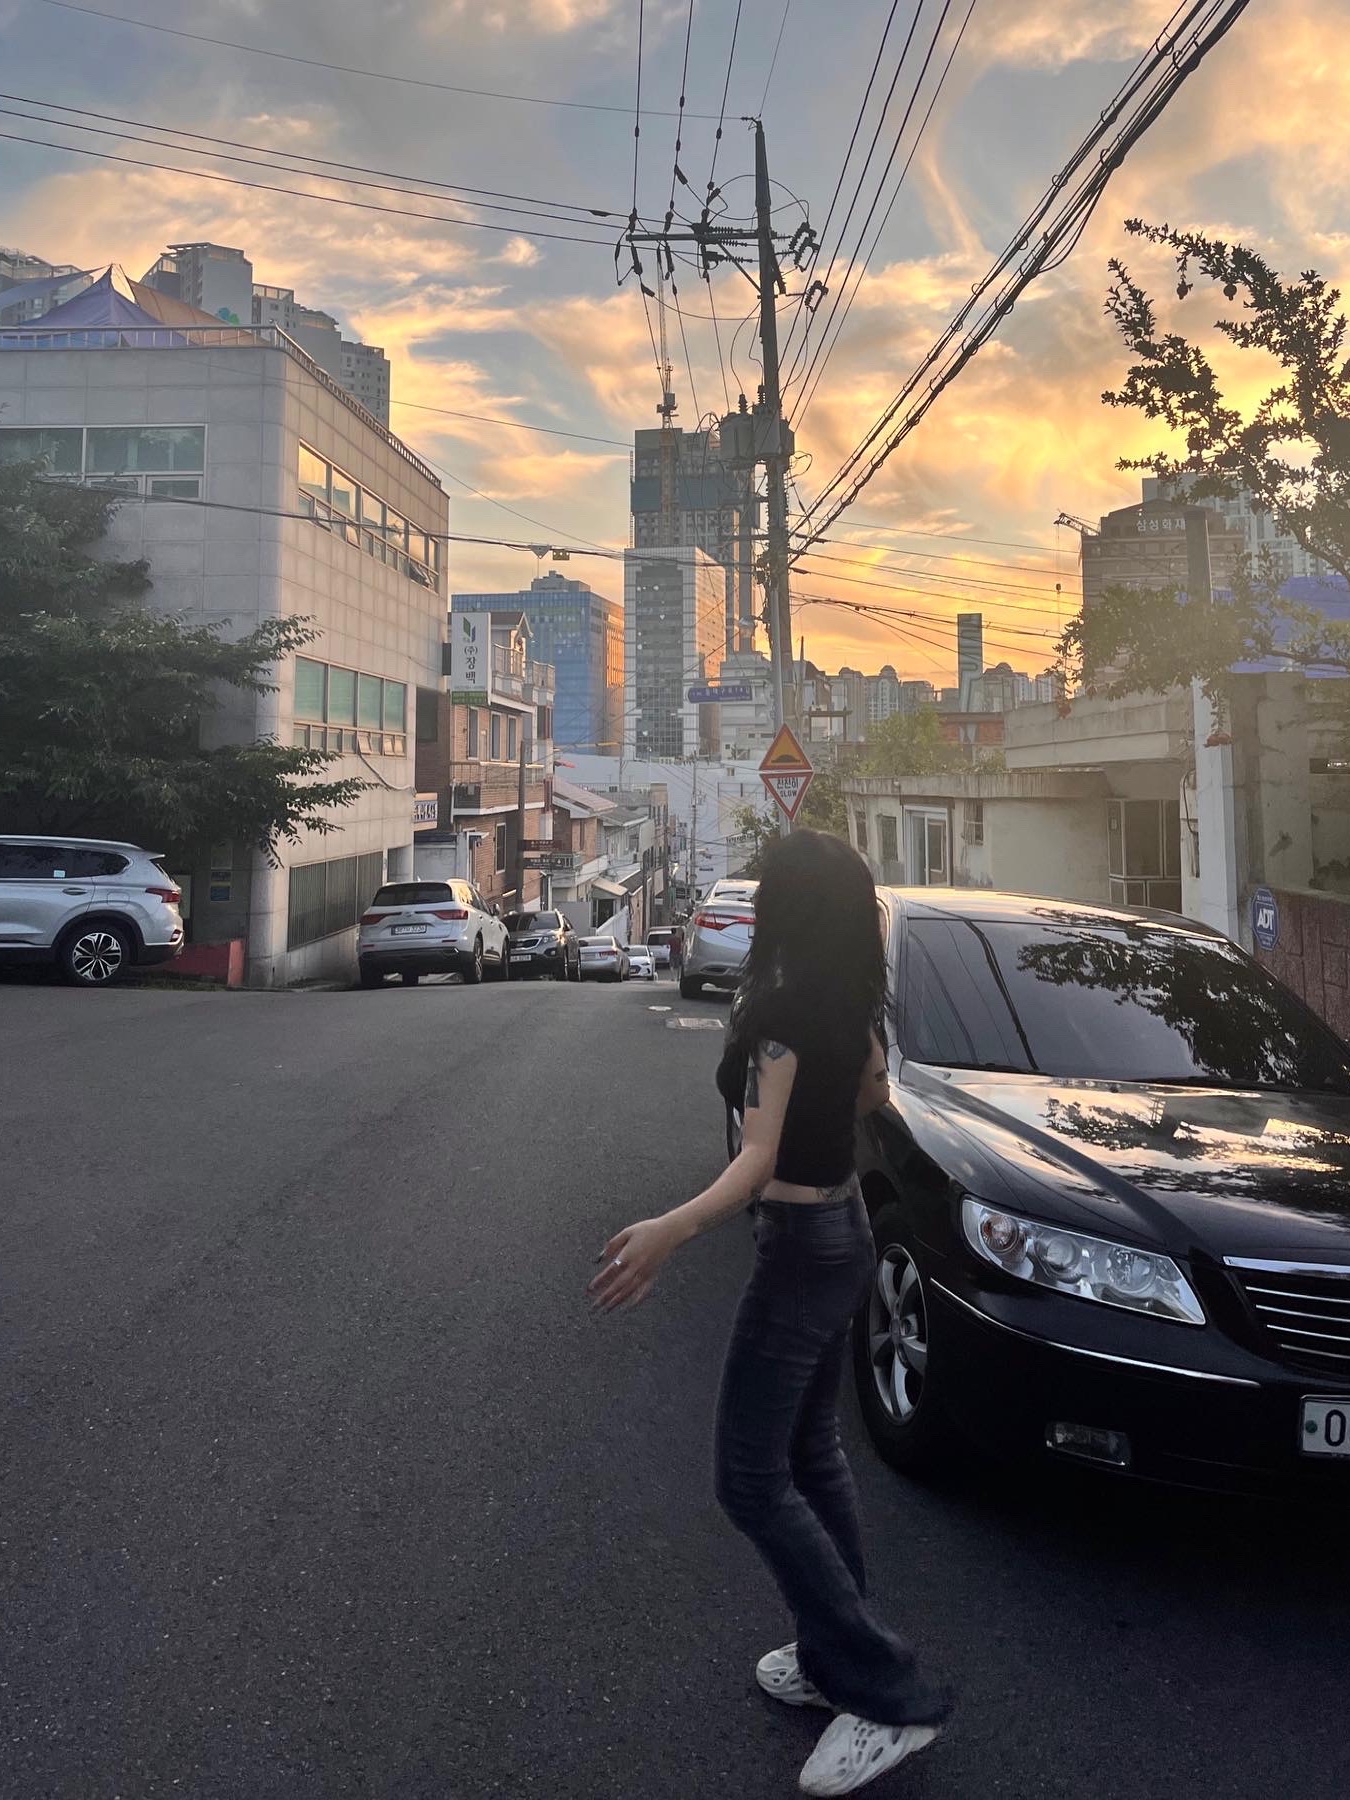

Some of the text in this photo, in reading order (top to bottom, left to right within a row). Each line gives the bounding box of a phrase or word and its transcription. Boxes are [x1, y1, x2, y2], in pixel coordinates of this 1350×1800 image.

[1136, 518, 1186, 532] 삼성화재
[776, 776, 799, 789] 천천히
[780, 790, 798, 798] SLOW
[1257, 908, 1275, 931] ADT
